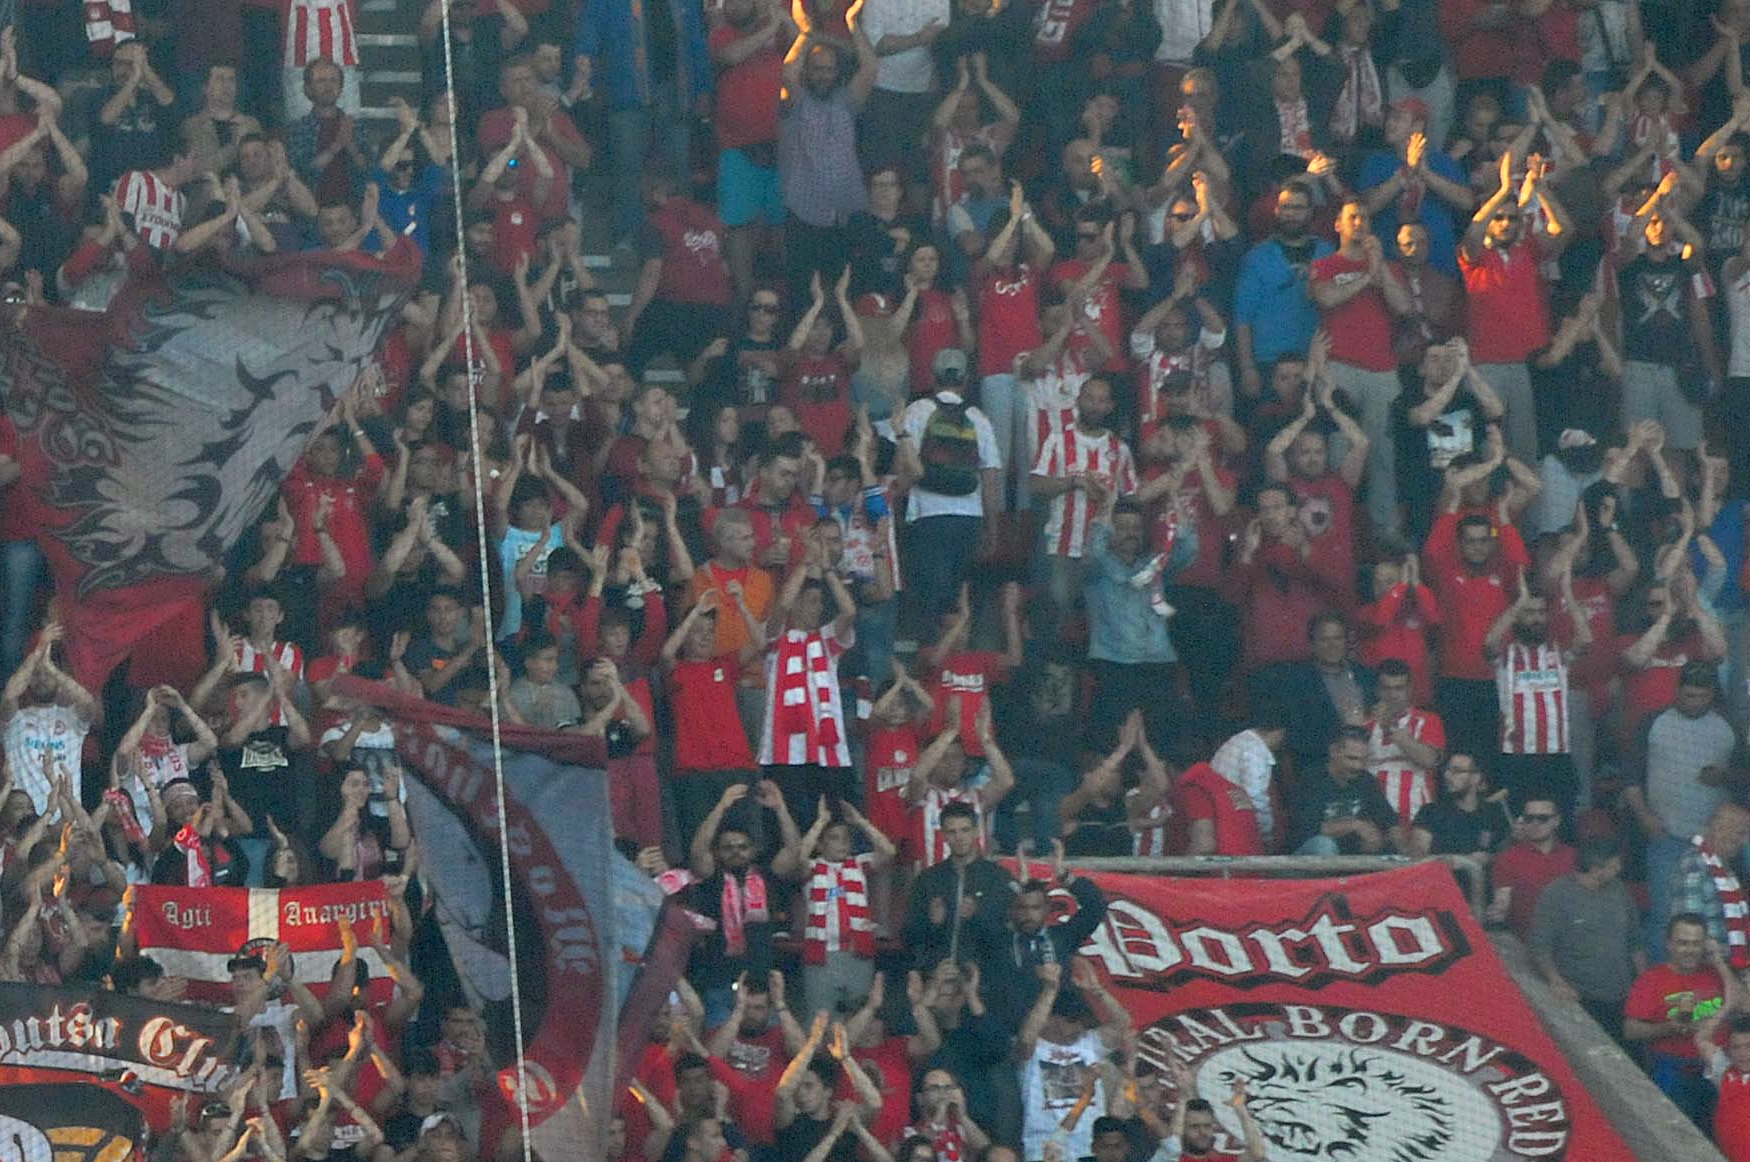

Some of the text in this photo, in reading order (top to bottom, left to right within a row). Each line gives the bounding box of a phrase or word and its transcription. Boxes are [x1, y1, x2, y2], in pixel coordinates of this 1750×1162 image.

[1079, 899, 1444, 979] Porto
[139, 1016, 230, 1092] Clu
[1283, 1004, 1506, 1073] BORN
[1488, 1072, 1565, 1157] RED
